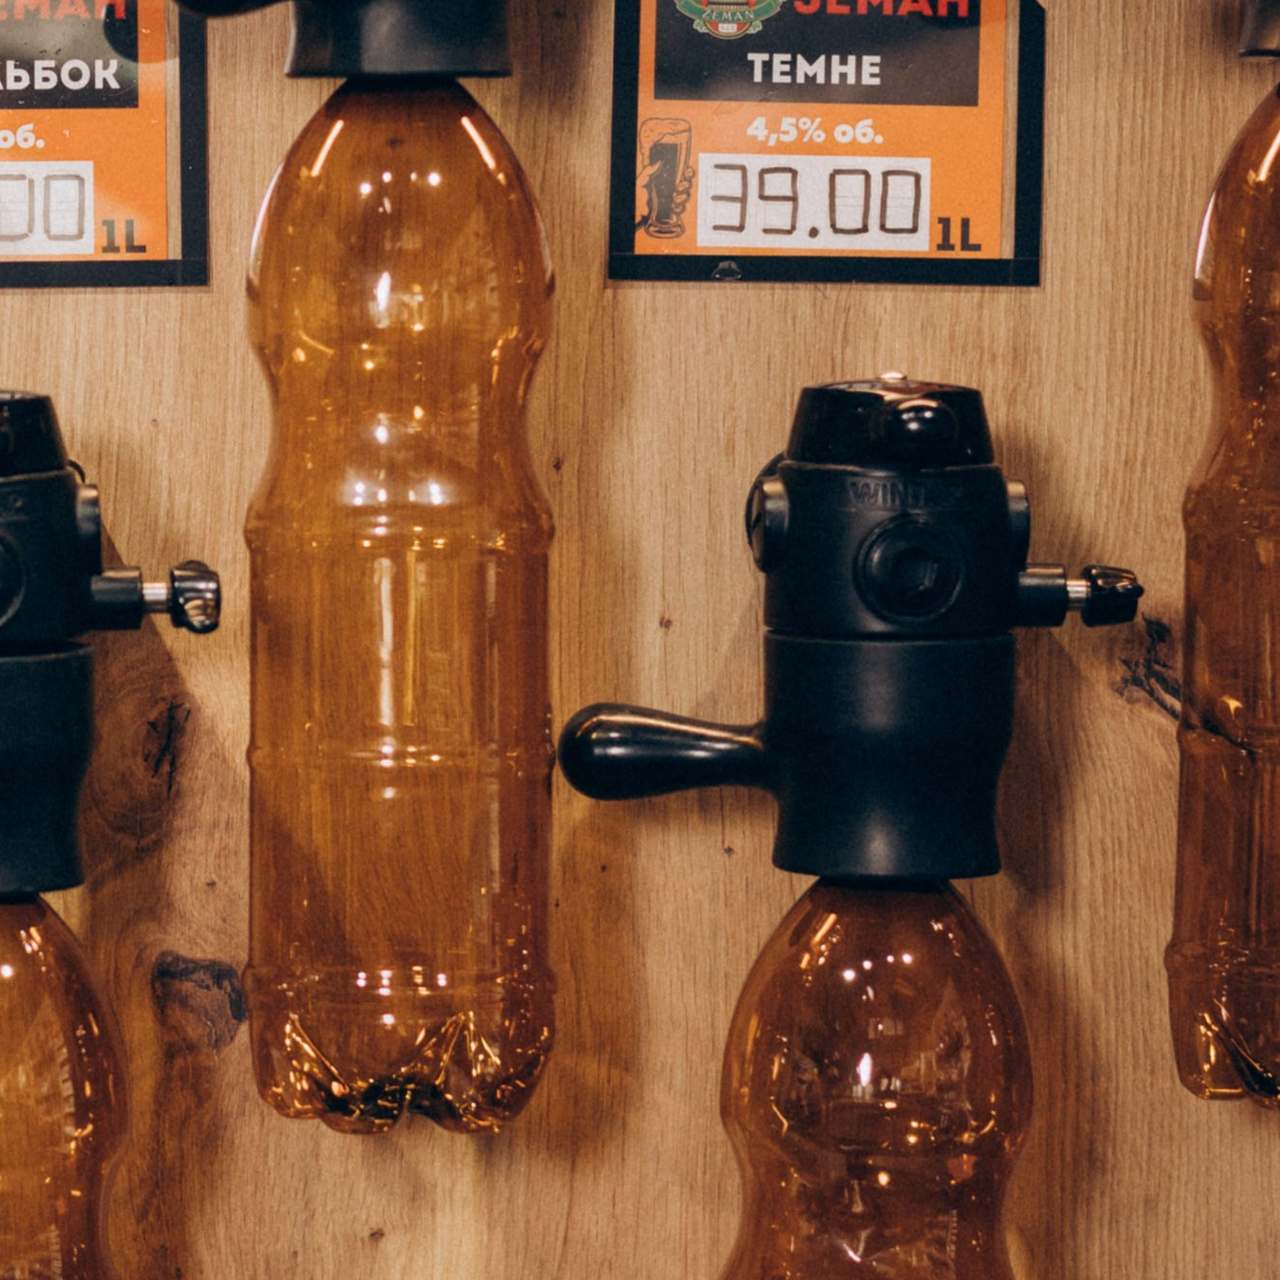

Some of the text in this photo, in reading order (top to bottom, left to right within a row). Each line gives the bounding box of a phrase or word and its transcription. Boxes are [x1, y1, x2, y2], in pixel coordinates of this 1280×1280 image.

[702, 10, 755, 21] ZEMAN
[747, 52, 881, 85] ТЕМНЕ
[746, 116, 826, 146] 4,5%
[711, 163, 921, 239] 39.00
[101, 219, 147, 253] 1L
[936, 217, 982, 252] 1L
